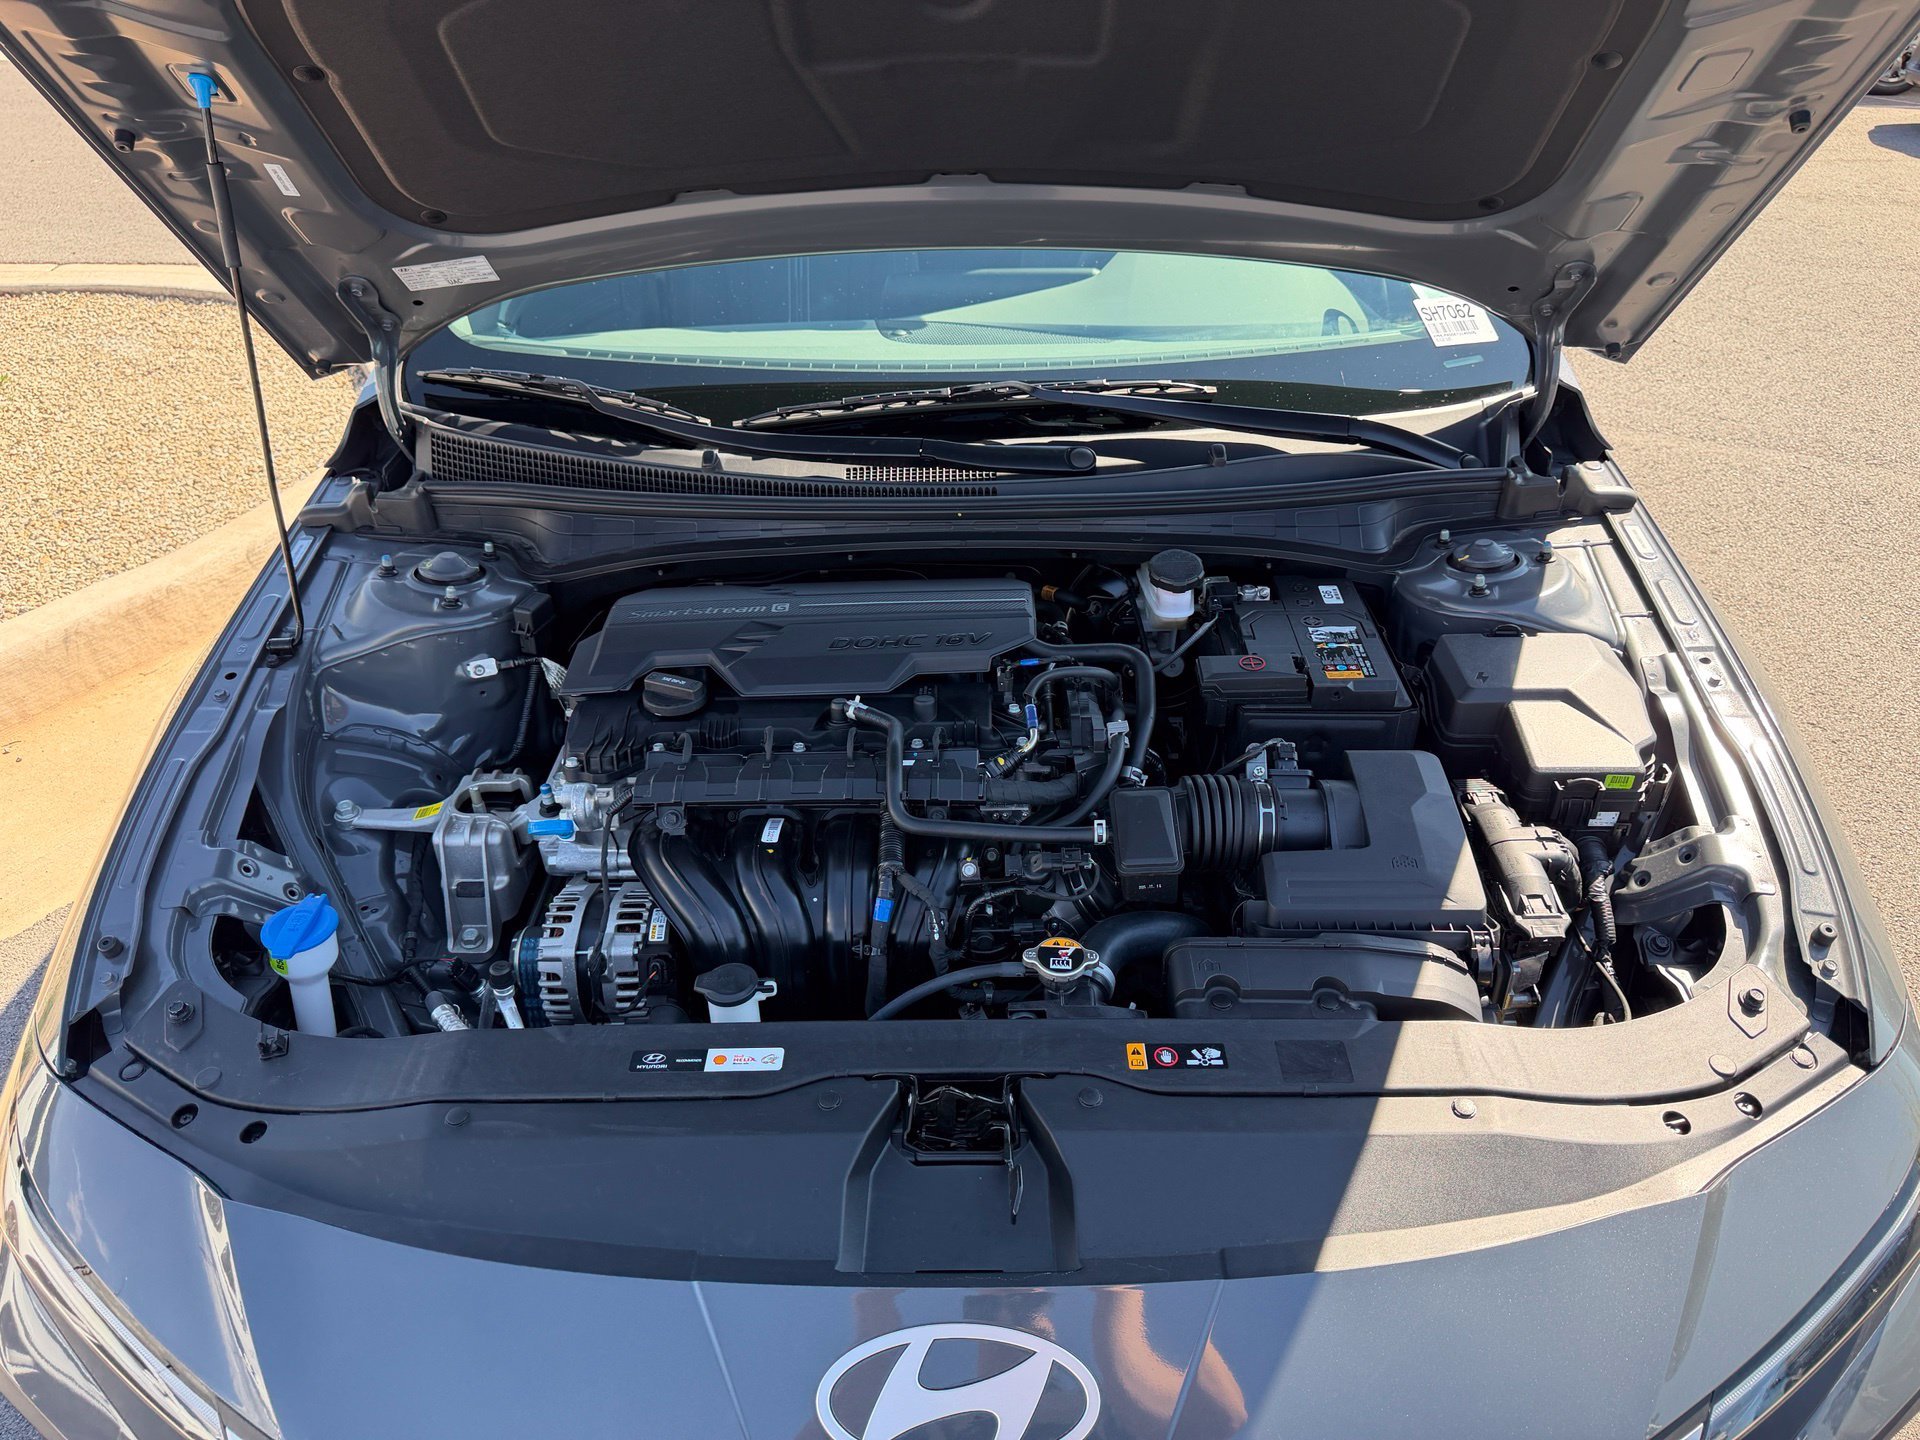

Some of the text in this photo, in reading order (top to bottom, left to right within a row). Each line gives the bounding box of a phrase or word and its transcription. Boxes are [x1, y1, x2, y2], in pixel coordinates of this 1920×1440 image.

[1420, 303, 1476, 322] SH7062
[628, 605, 767, 619] Smartstream
[828, 631, 993, 650] DOHC 16V
